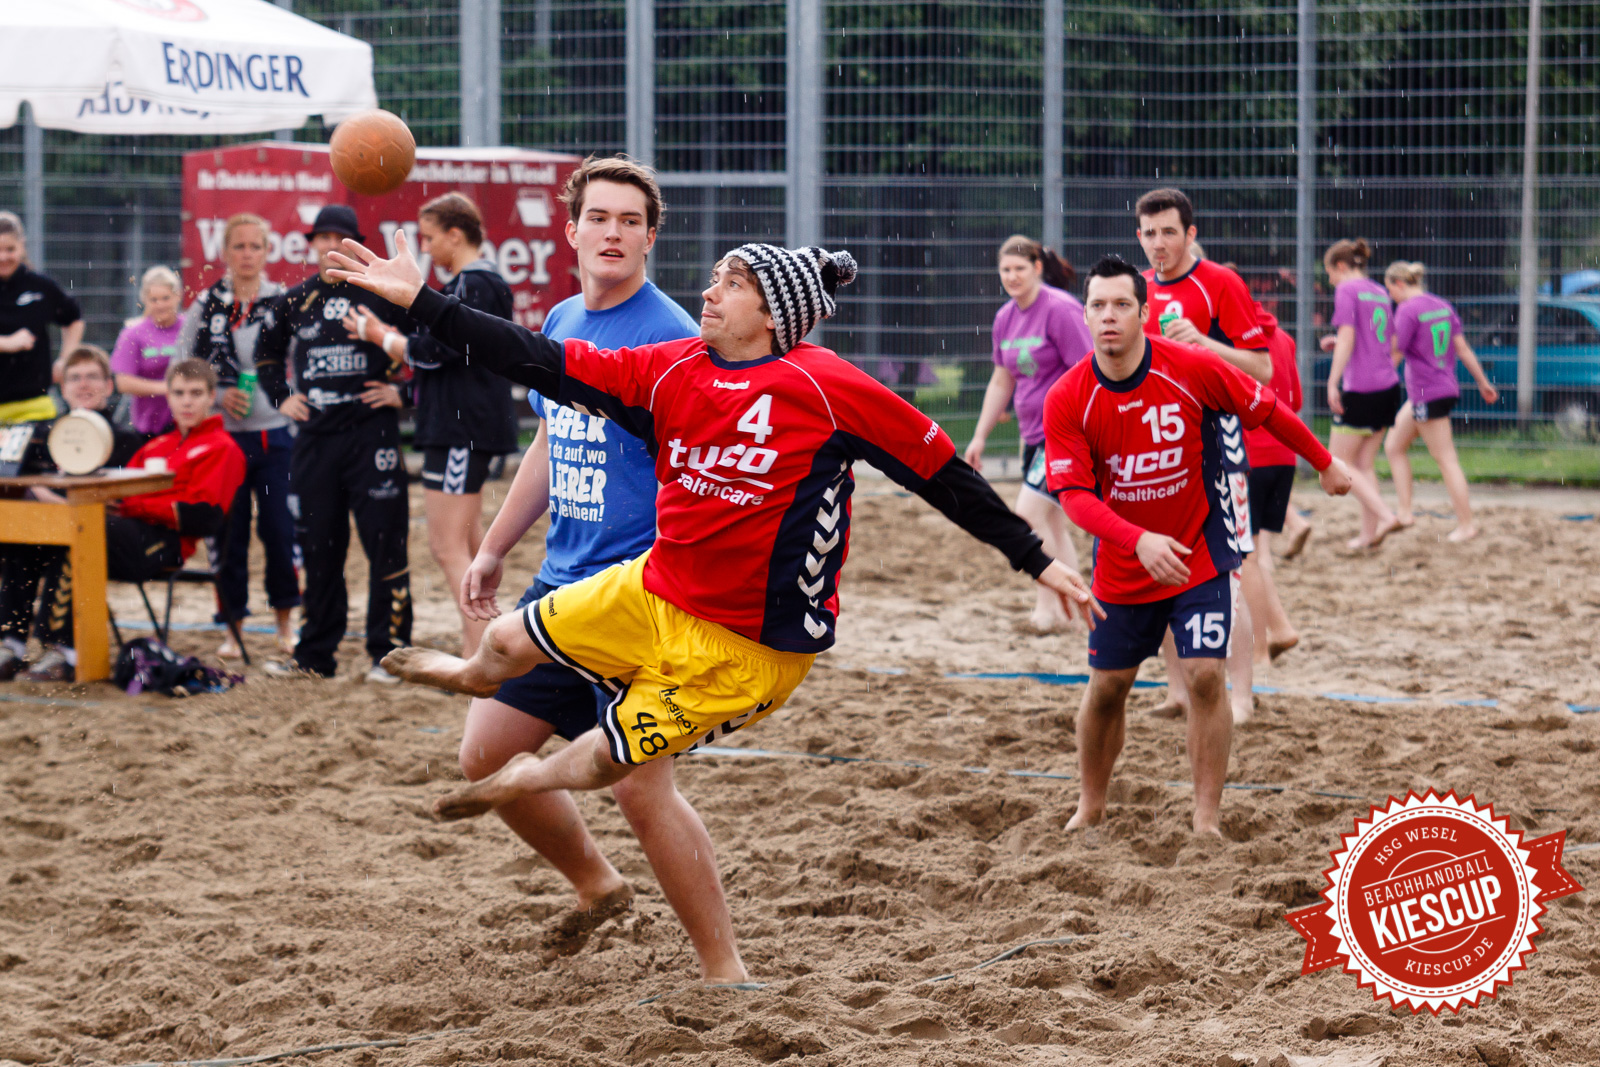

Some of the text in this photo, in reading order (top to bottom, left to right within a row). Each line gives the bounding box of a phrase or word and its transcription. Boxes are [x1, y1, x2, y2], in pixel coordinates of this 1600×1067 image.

[161, 42, 310, 98] ERDINGER
[210, 313, 227, 335] 8
[324, 297, 349, 320] 69
[327, 353, 367, 372] 360
[737, 394, 773, 444] 4
[1141, 402, 1185, 443] 15
[375, 448, 398, 471] 69
[1105, 446, 1184, 482] tyco
[1110, 478, 1189, 503] Healthcare
[1184, 612, 1225, 650] 15
[631, 712, 669, 756] 48
